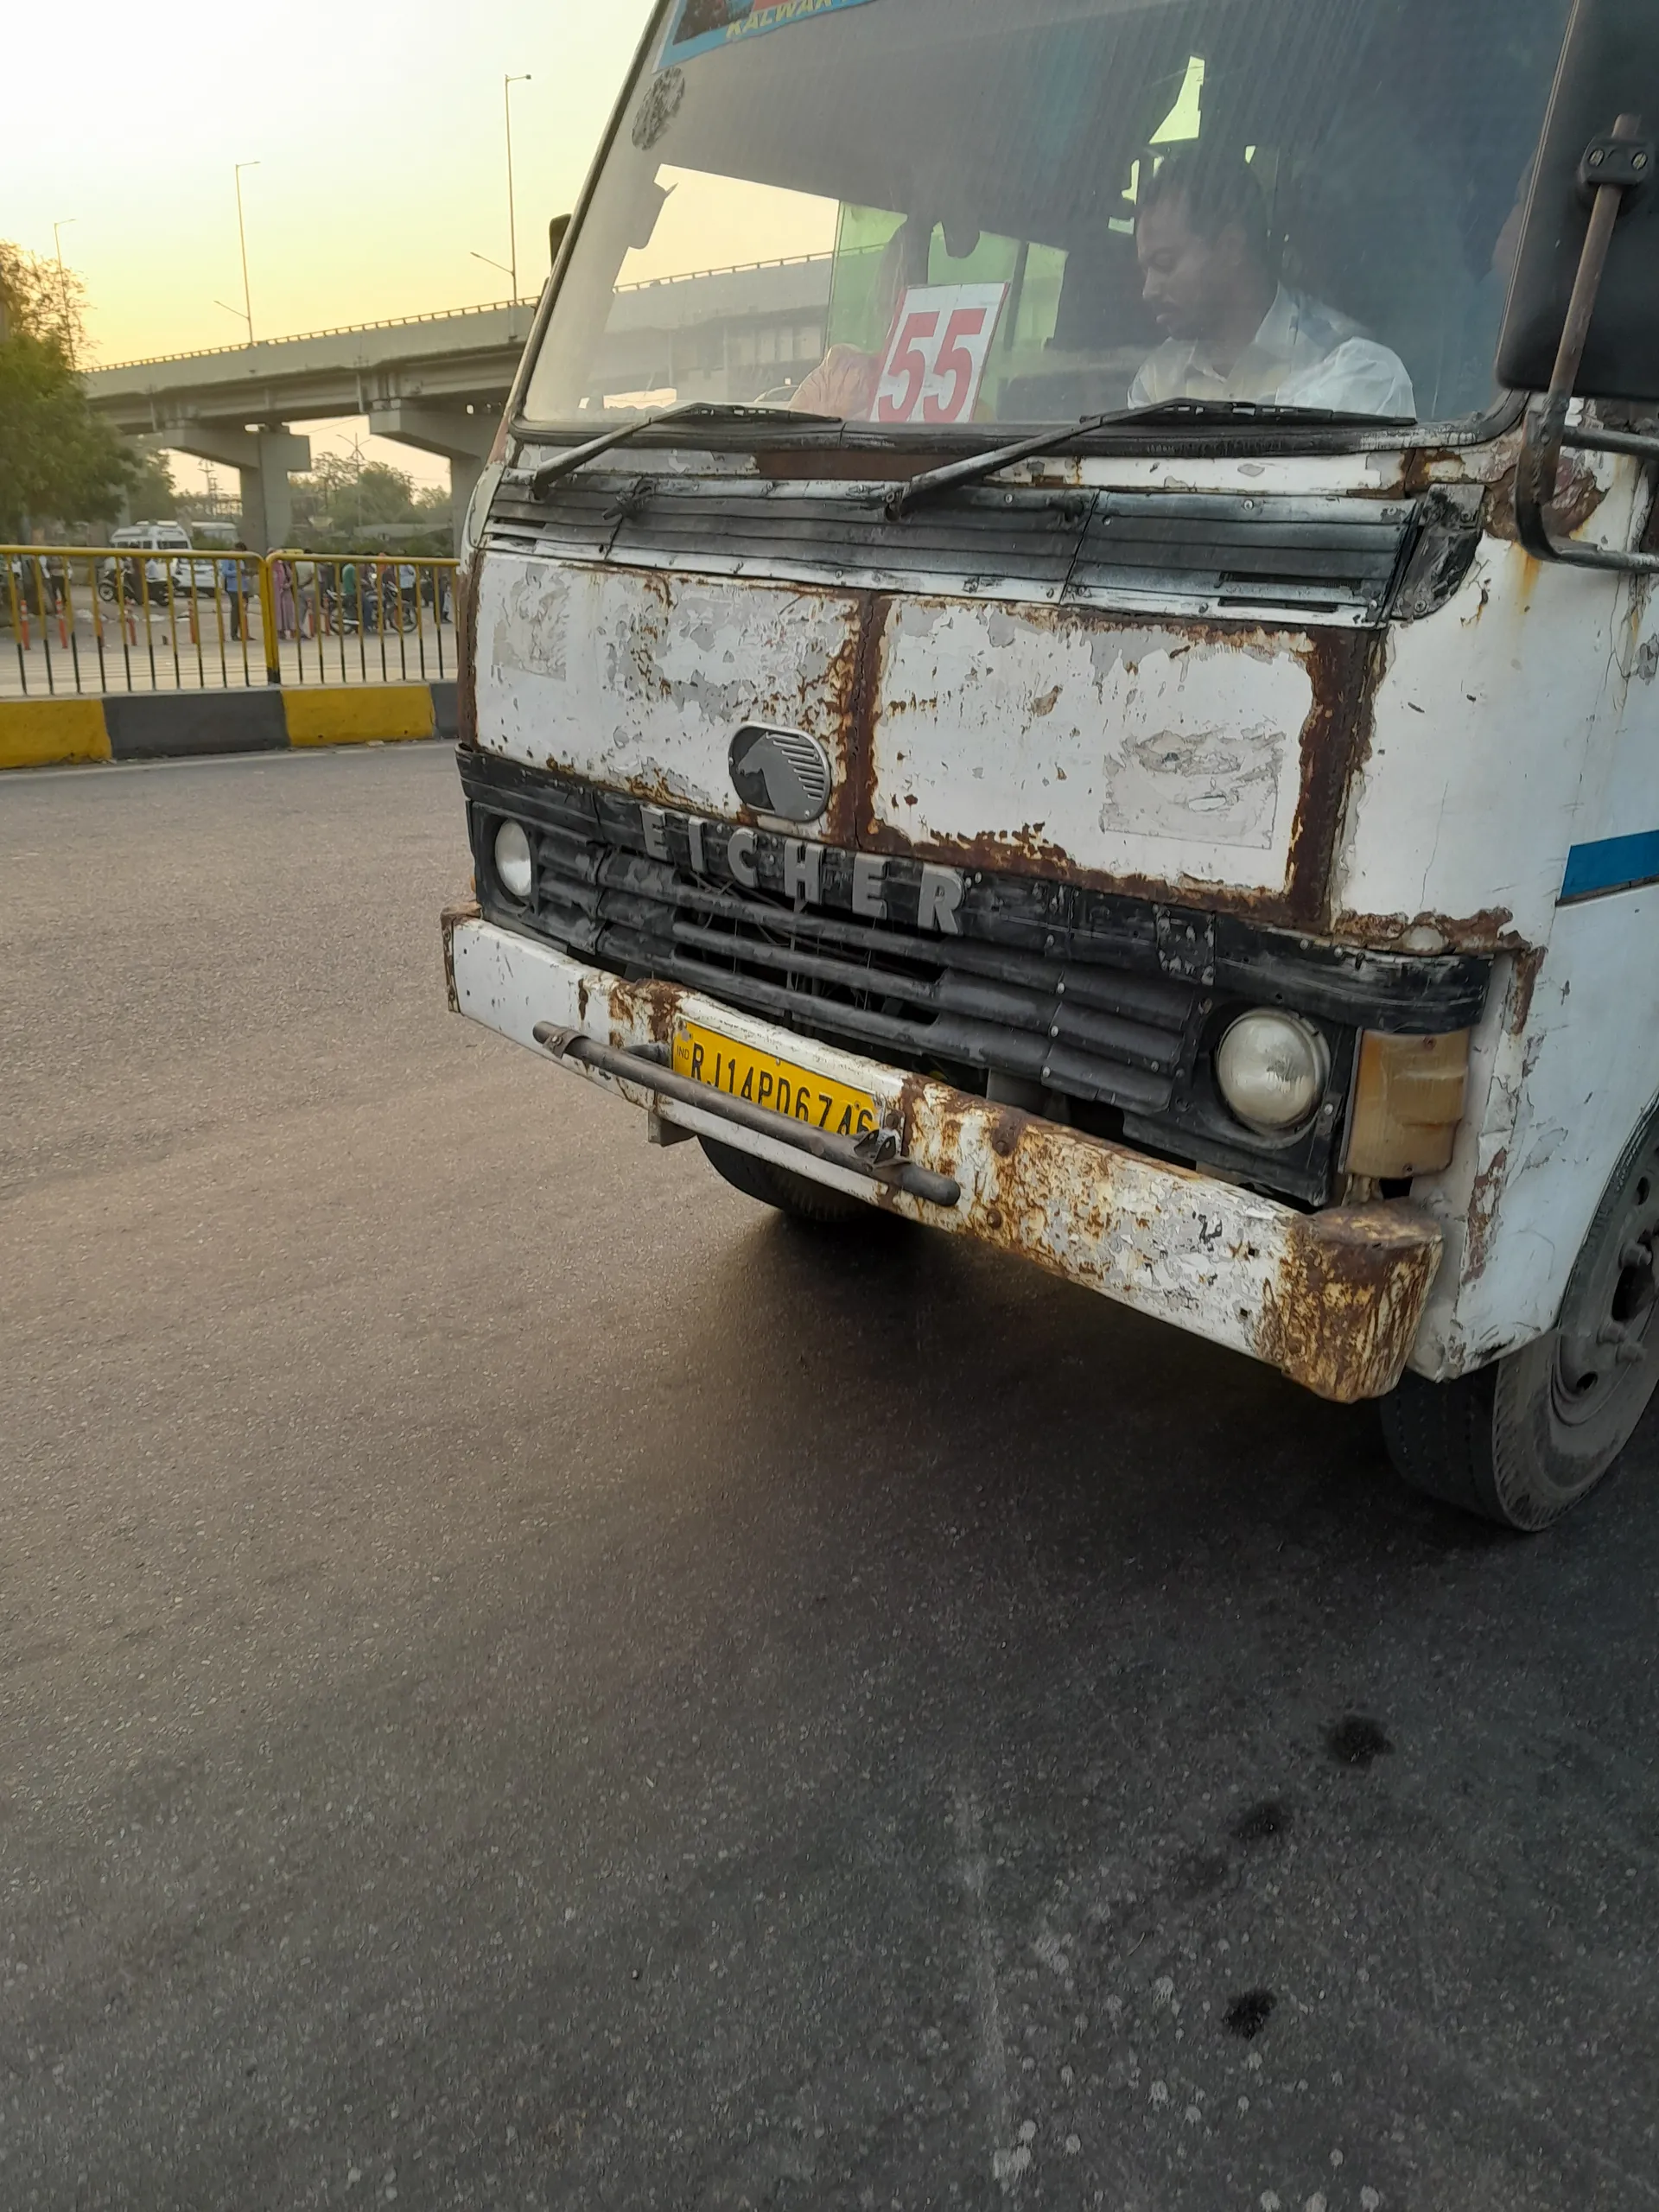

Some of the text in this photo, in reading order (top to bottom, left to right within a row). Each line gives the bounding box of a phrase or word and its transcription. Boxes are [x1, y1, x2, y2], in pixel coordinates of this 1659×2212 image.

[877, 307, 988, 423] 55
[639, 803, 965, 936] EICHER
[677, 1044, 690, 1061] IND
